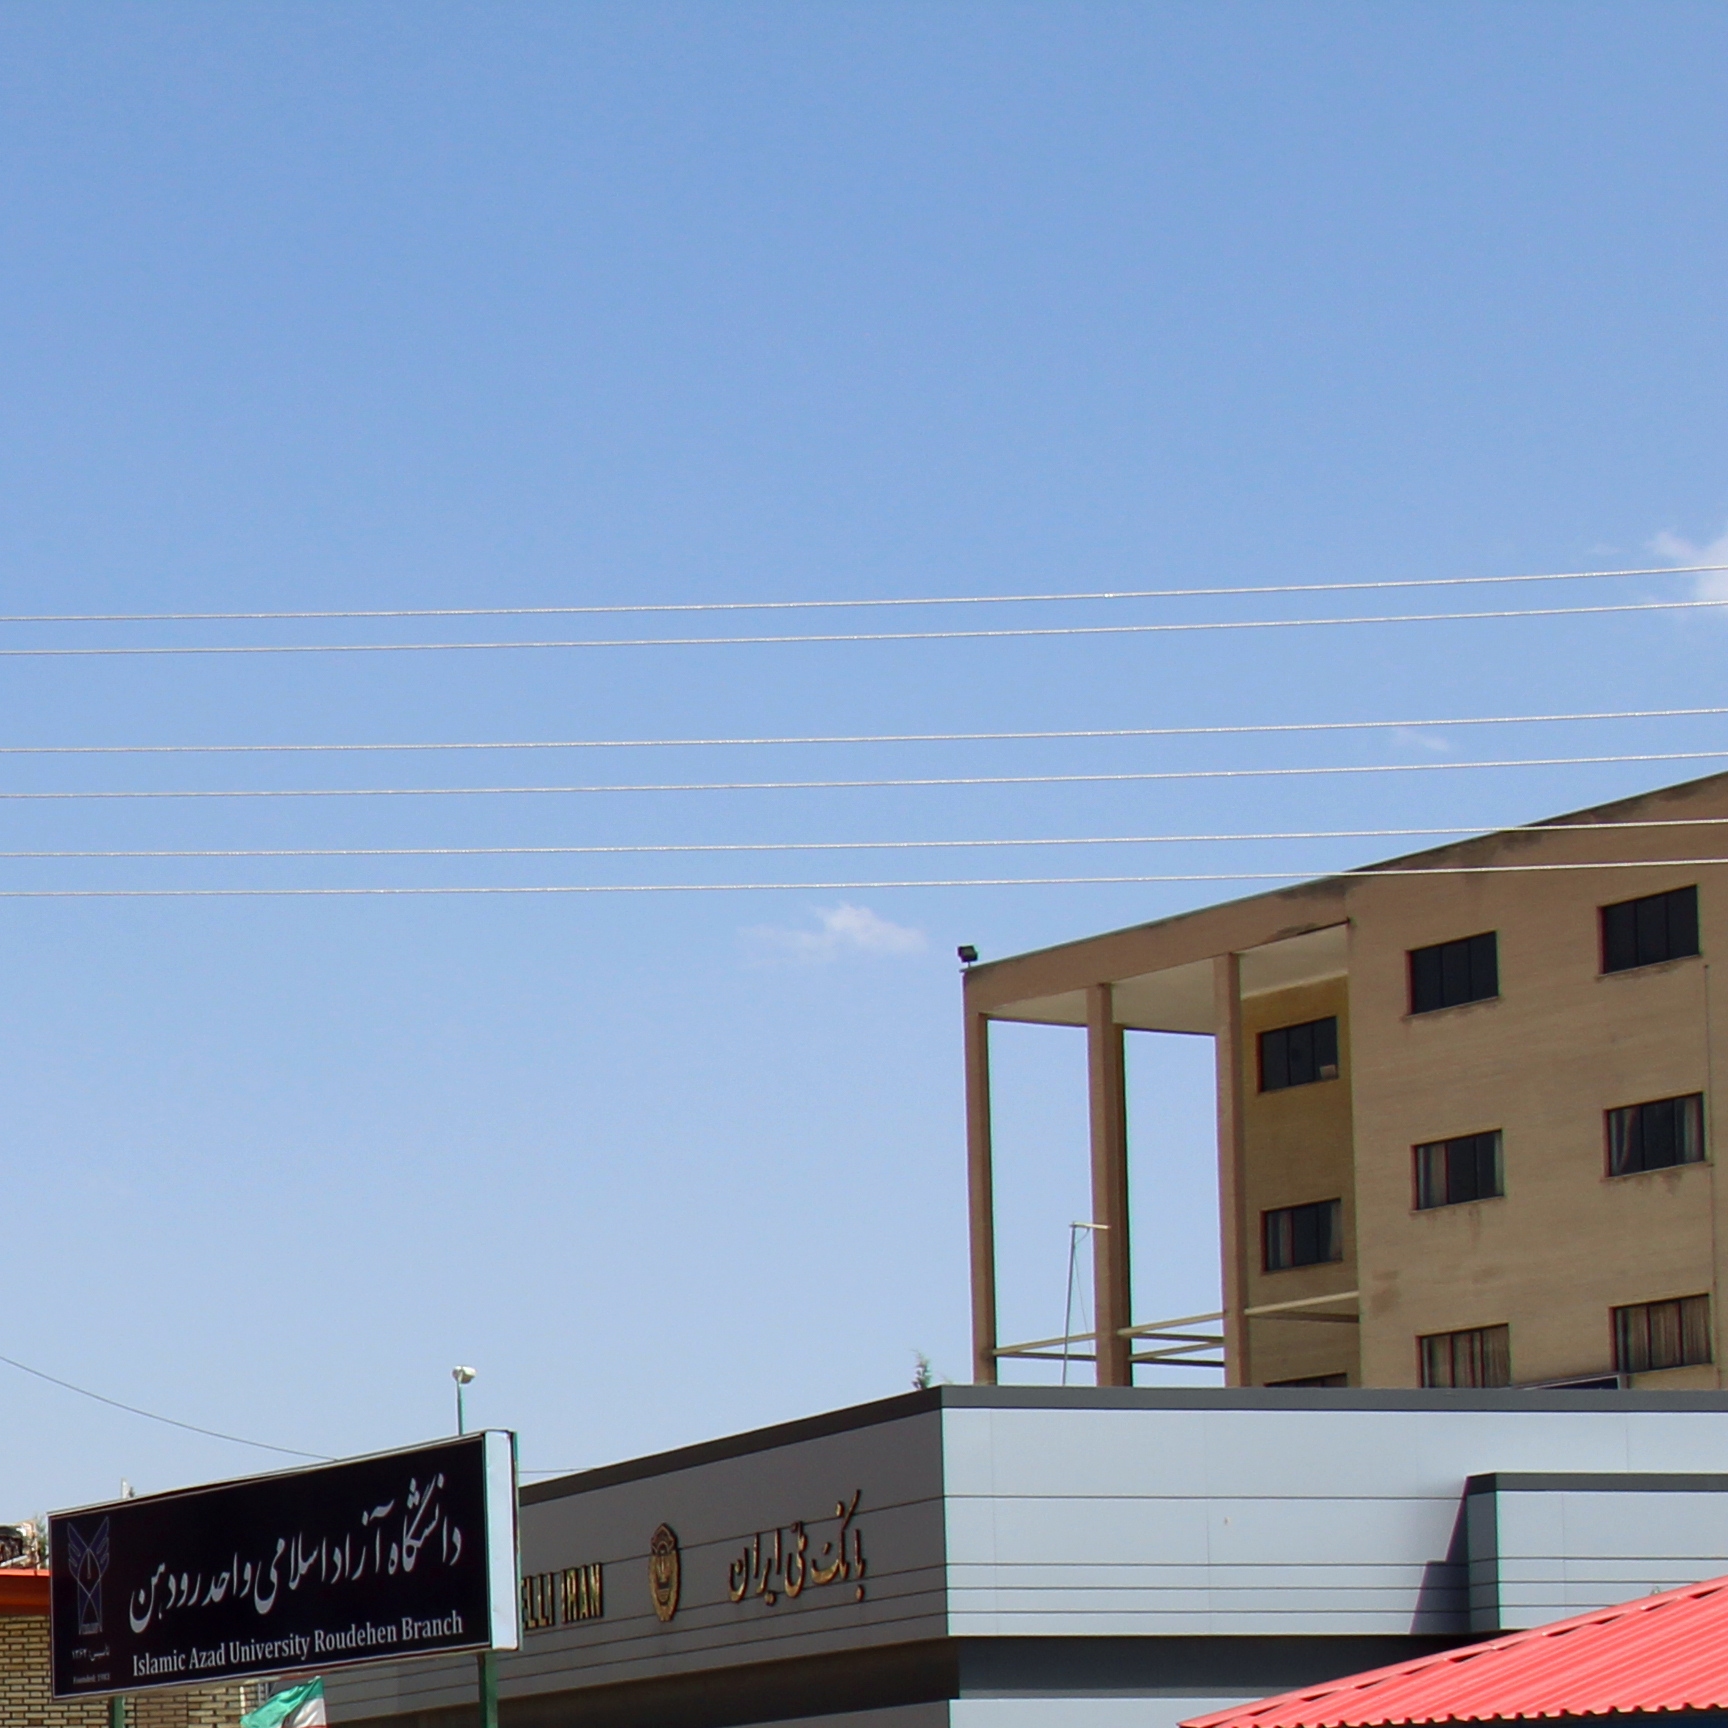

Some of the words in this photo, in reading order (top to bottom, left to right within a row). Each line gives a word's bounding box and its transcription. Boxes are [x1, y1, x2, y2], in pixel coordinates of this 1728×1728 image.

[331, 1498, 395, 1584] آزاد
[388, 1472, 462, 1575] دانشگاه
[785, 1521, 808, 1598] ملی
[811, 1488, 866, 1602] بانک
[129, 1562, 201, 1634] رودهن
[202, 1552, 252, 1607] واحد
[254, 1531, 327, 1615] اسلامی
[561, 1562, 603, 1624] IRAN
[728, 1528, 782, 1606] ایران
[133, 1650, 186, 1677] Islamic
[189, 1643, 226, 1670] Azad
[229, 1632, 311, 1663] University
[314, 1621, 398, 1653] Roudehen
[401, 1609, 464, 1640] Branch
